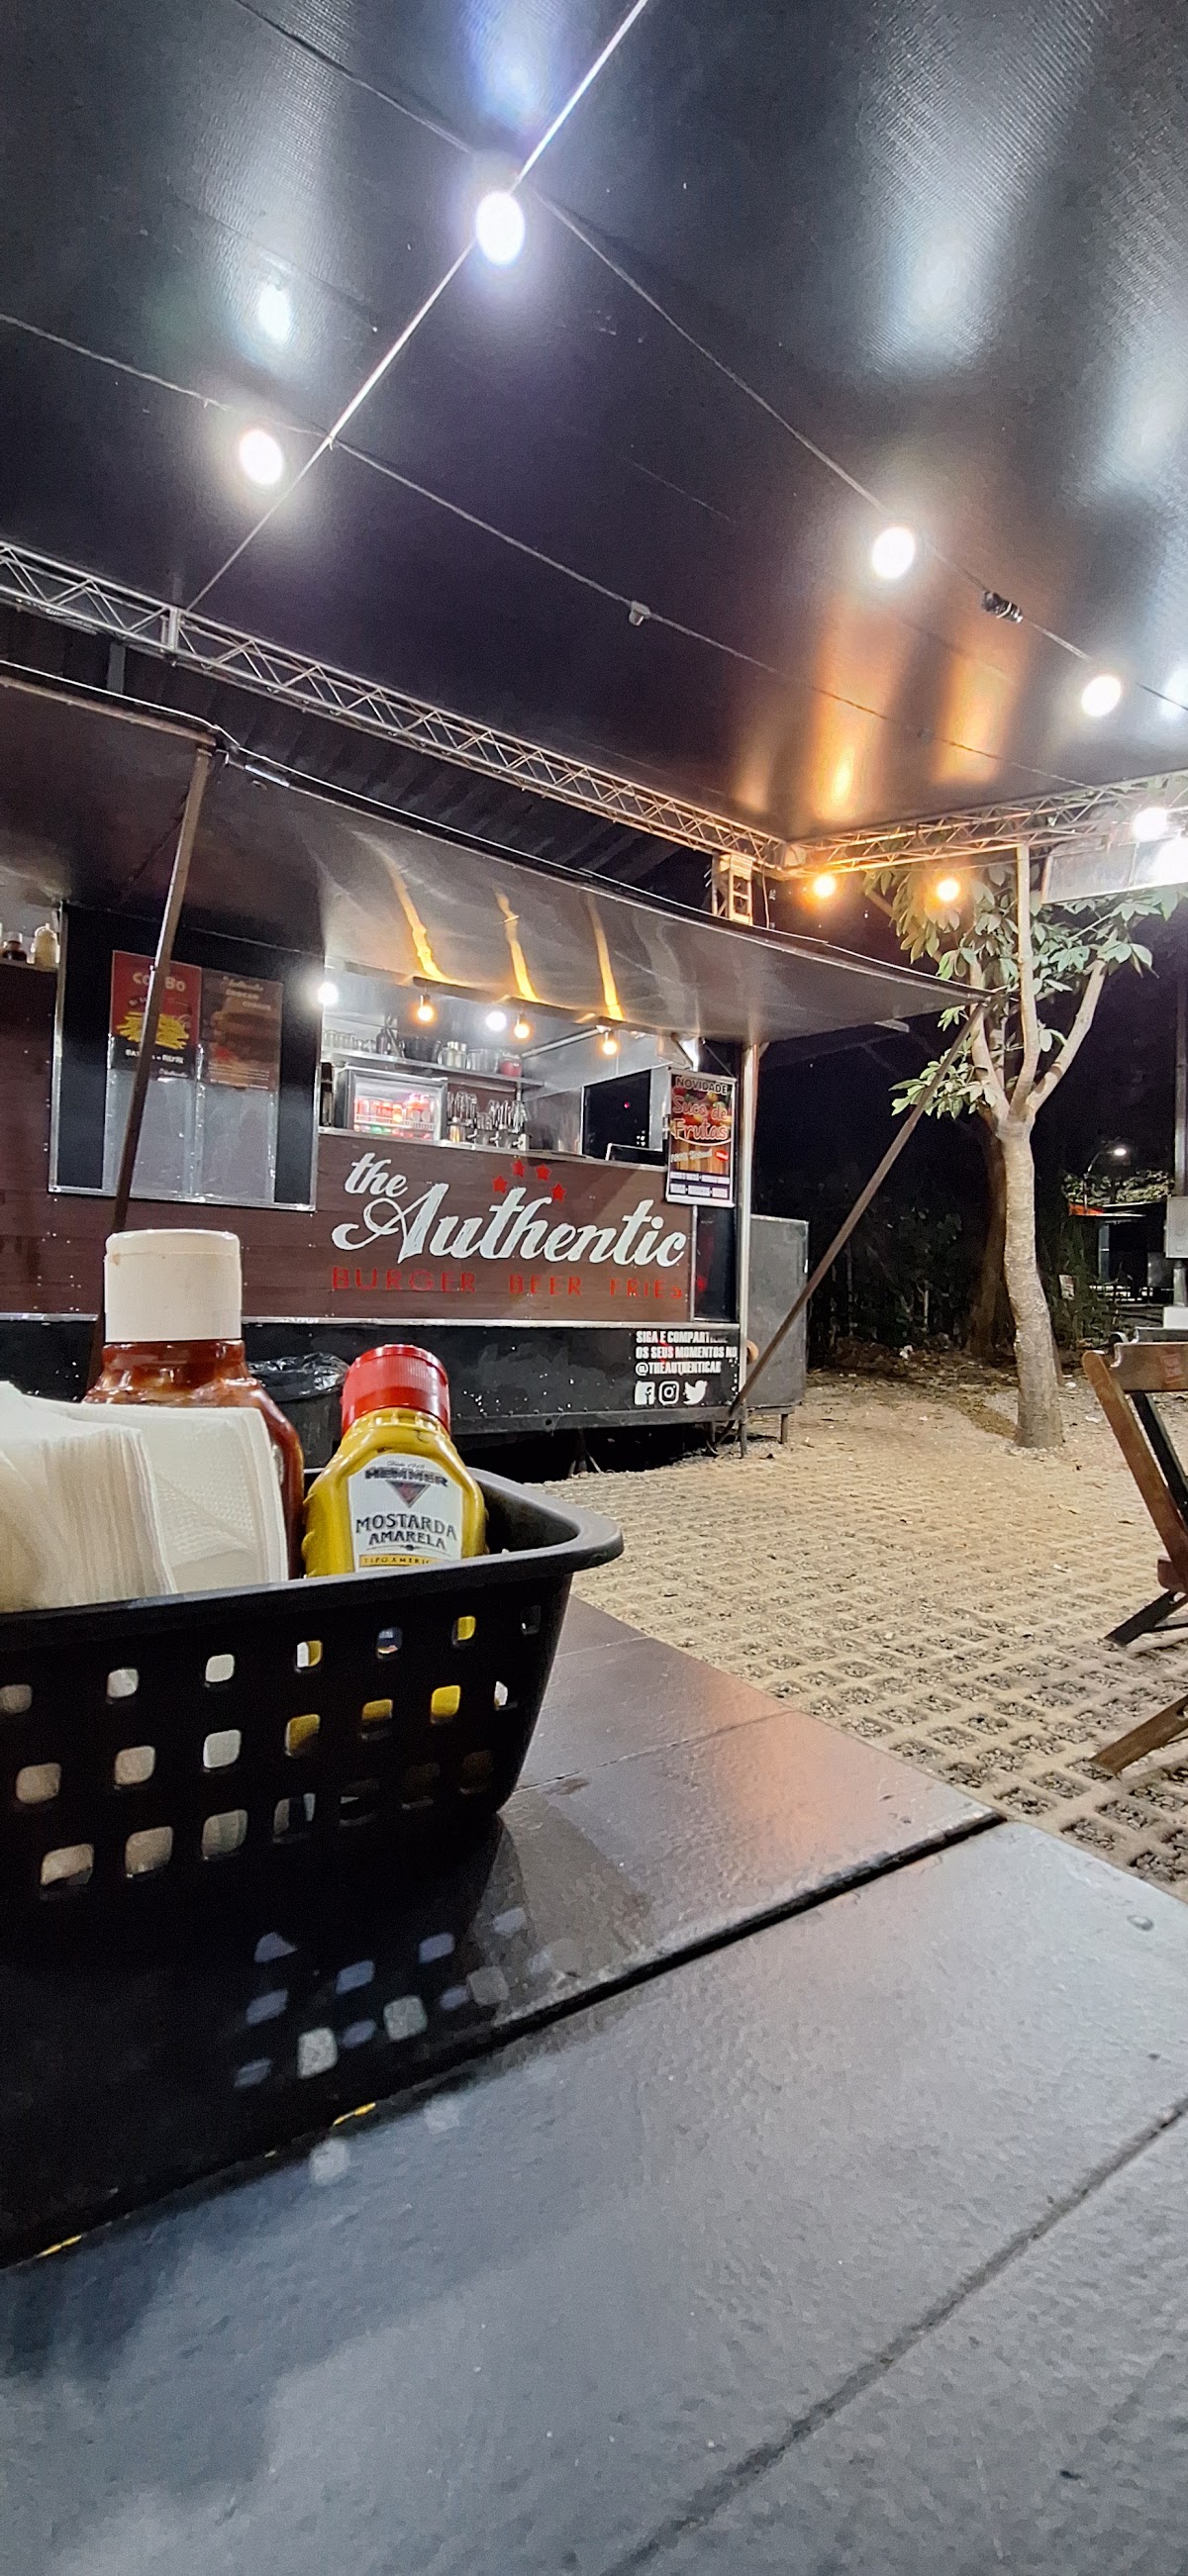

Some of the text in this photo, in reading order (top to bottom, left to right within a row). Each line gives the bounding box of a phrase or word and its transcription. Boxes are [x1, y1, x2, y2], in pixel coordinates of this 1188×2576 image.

[133, 972, 186, 992] COBO
[675, 1077, 728, 1096] NOVIDADE
[712, 1103, 728, 1120] de
[673, 1118, 728, 1140] Frutas
[345, 1152, 409, 1197] the
[332, 1183, 687, 1268] Authentic
[332, 1267, 682, 1298] BURGER BEER FRIES
[636, 1330, 658, 1343] SIGA
[659, 1330, 666, 1343] E
[636, 1346, 738, 1359] OS SEUS MOMENTOS NO
[365, 1467, 447, 1486] HEMMER
[355, 1513, 457, 1541] MOSTARDA
[368, 1531, 446, 1552] AMARELA
